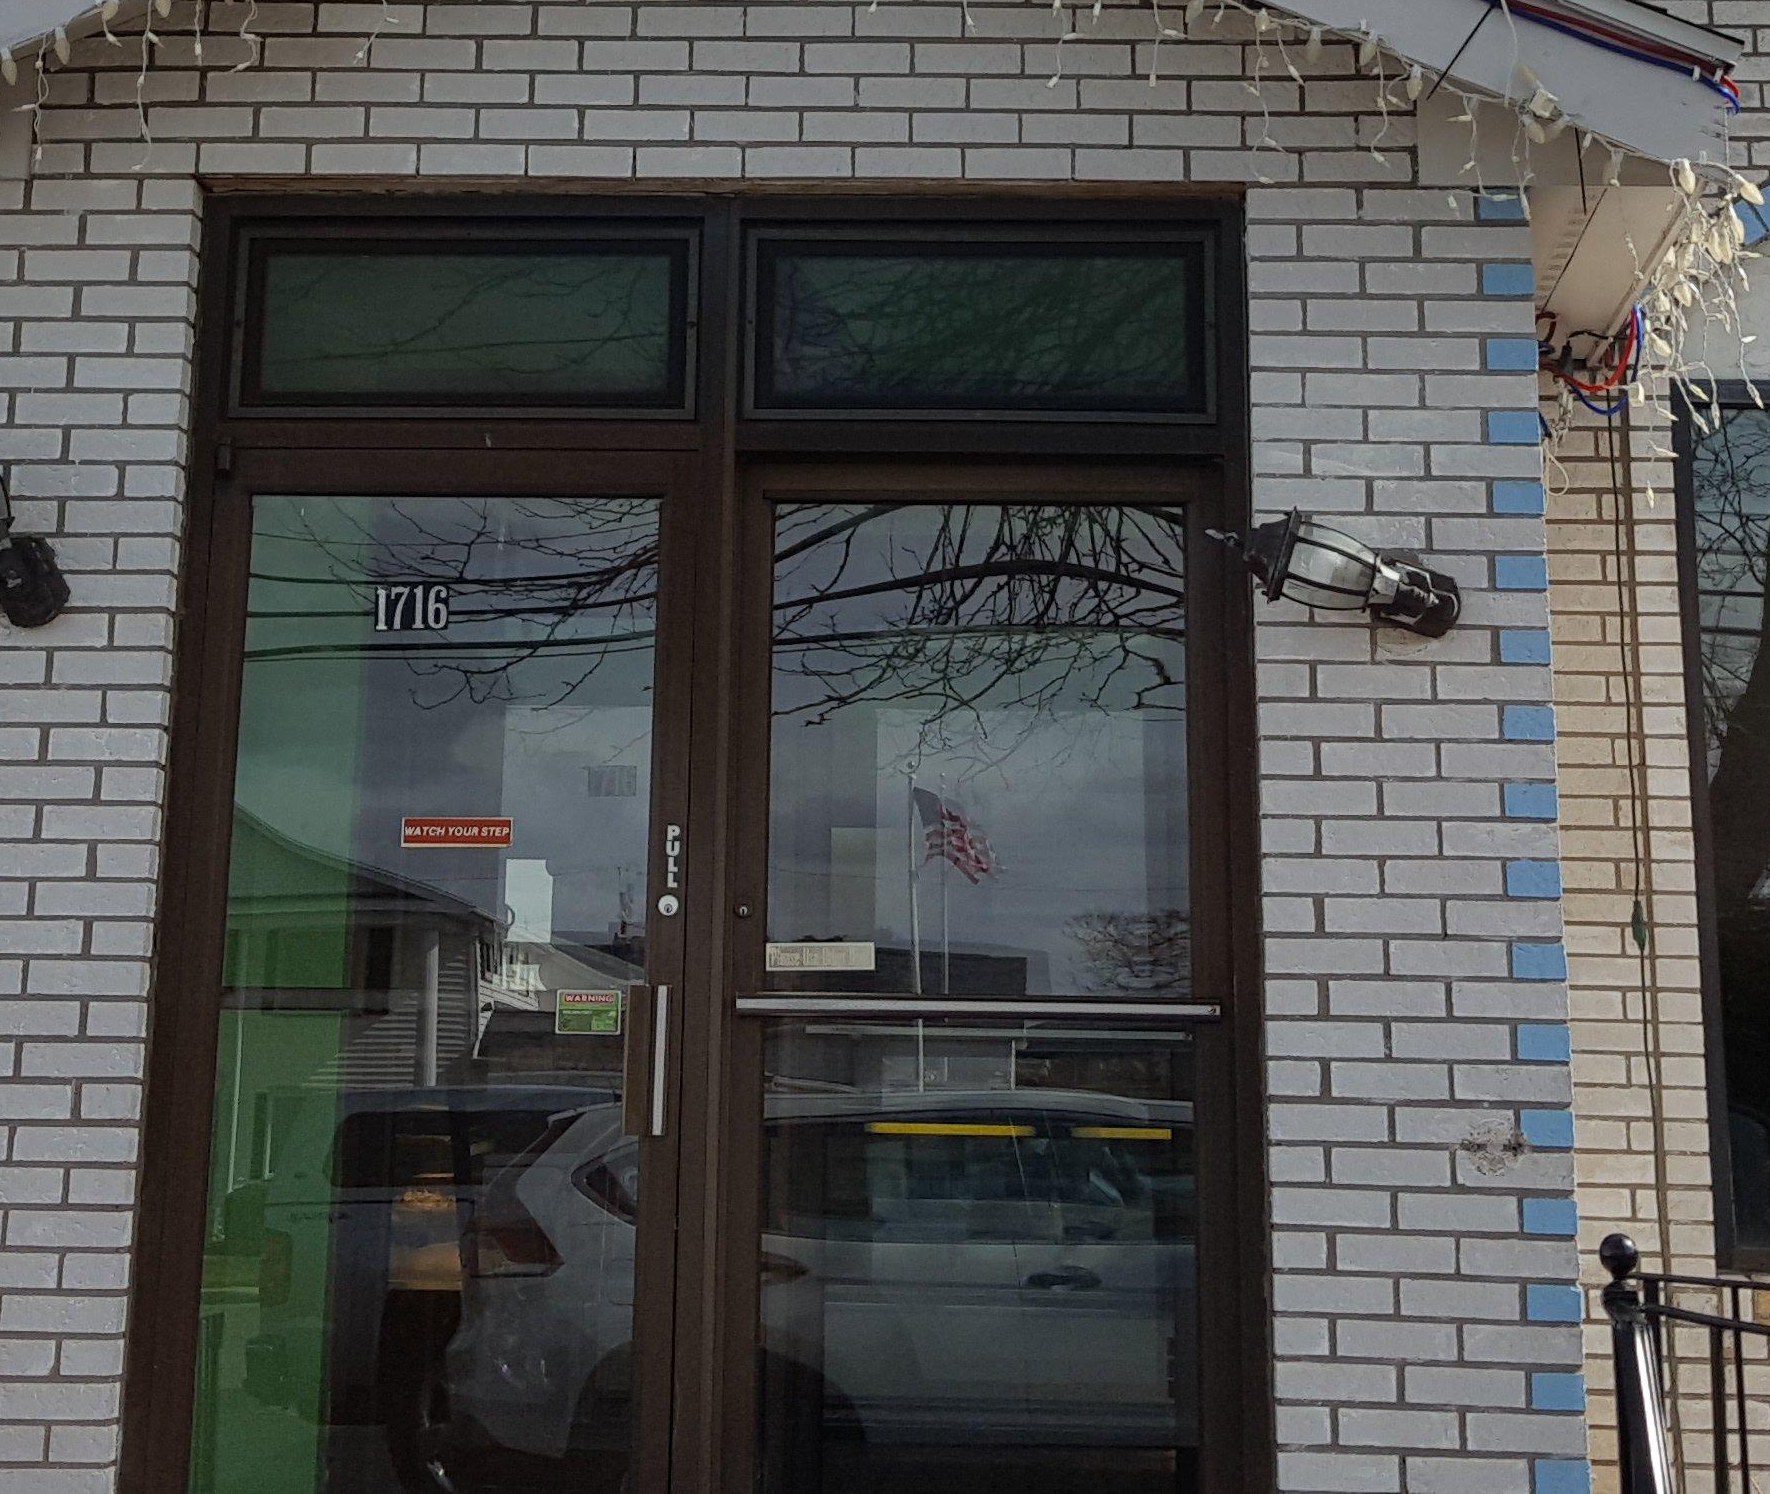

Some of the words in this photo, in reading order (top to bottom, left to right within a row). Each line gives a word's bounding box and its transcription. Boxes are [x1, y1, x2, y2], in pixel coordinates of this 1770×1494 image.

[374, 585, 448, 631] 1716
[404, 826, 445, 837] WATCH
[448, 826, 479, 837] YOUR
[481, 826, 510, 837] STEP
[665, 824, 681, 888] PULL
[565, 994, 614, 1002] WARNING
